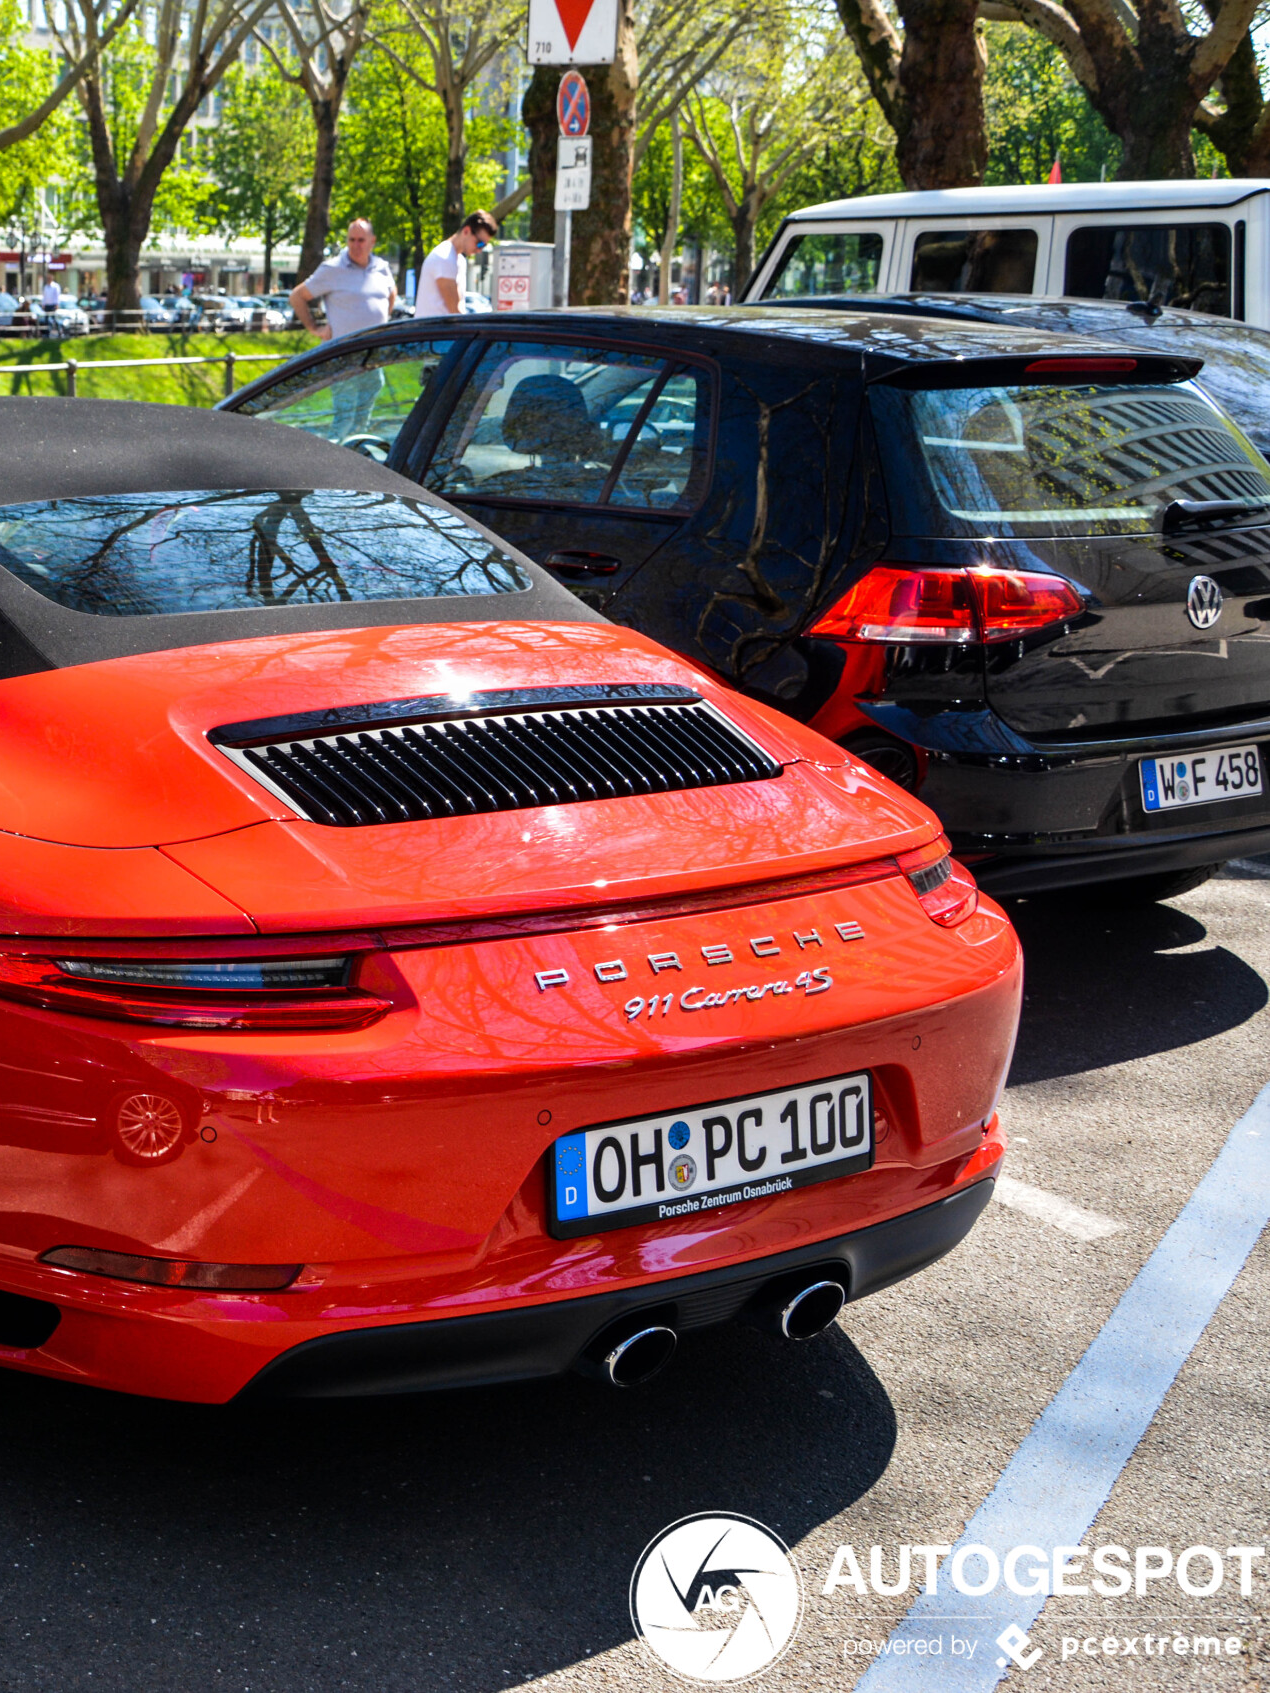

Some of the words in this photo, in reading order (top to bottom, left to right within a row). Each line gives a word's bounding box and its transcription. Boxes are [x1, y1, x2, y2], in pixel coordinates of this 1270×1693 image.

[535, 41, 552, 54] 710
[1159, 761, 1176, 802] W
[1191, 757, 1206, 797] F
[1215, 750, 1260, 793] 458
[534, 920, 866, 992] PORSCHE
[624, 992, 675, 1022] 911
[678, 980, 794, 1012] Carrera
[794, 965, 834, 998] 4S
[592, 1127, 666, 1204] OH
[701, 1107, 768, 1182] PC
[779, 1084, 865, 1165] 100
[658, 1199, 701, 1219] Porsche
[700, 1189, 743, 1210] Zentrum
[742, 1176, 793, 1200] Osnabrück
